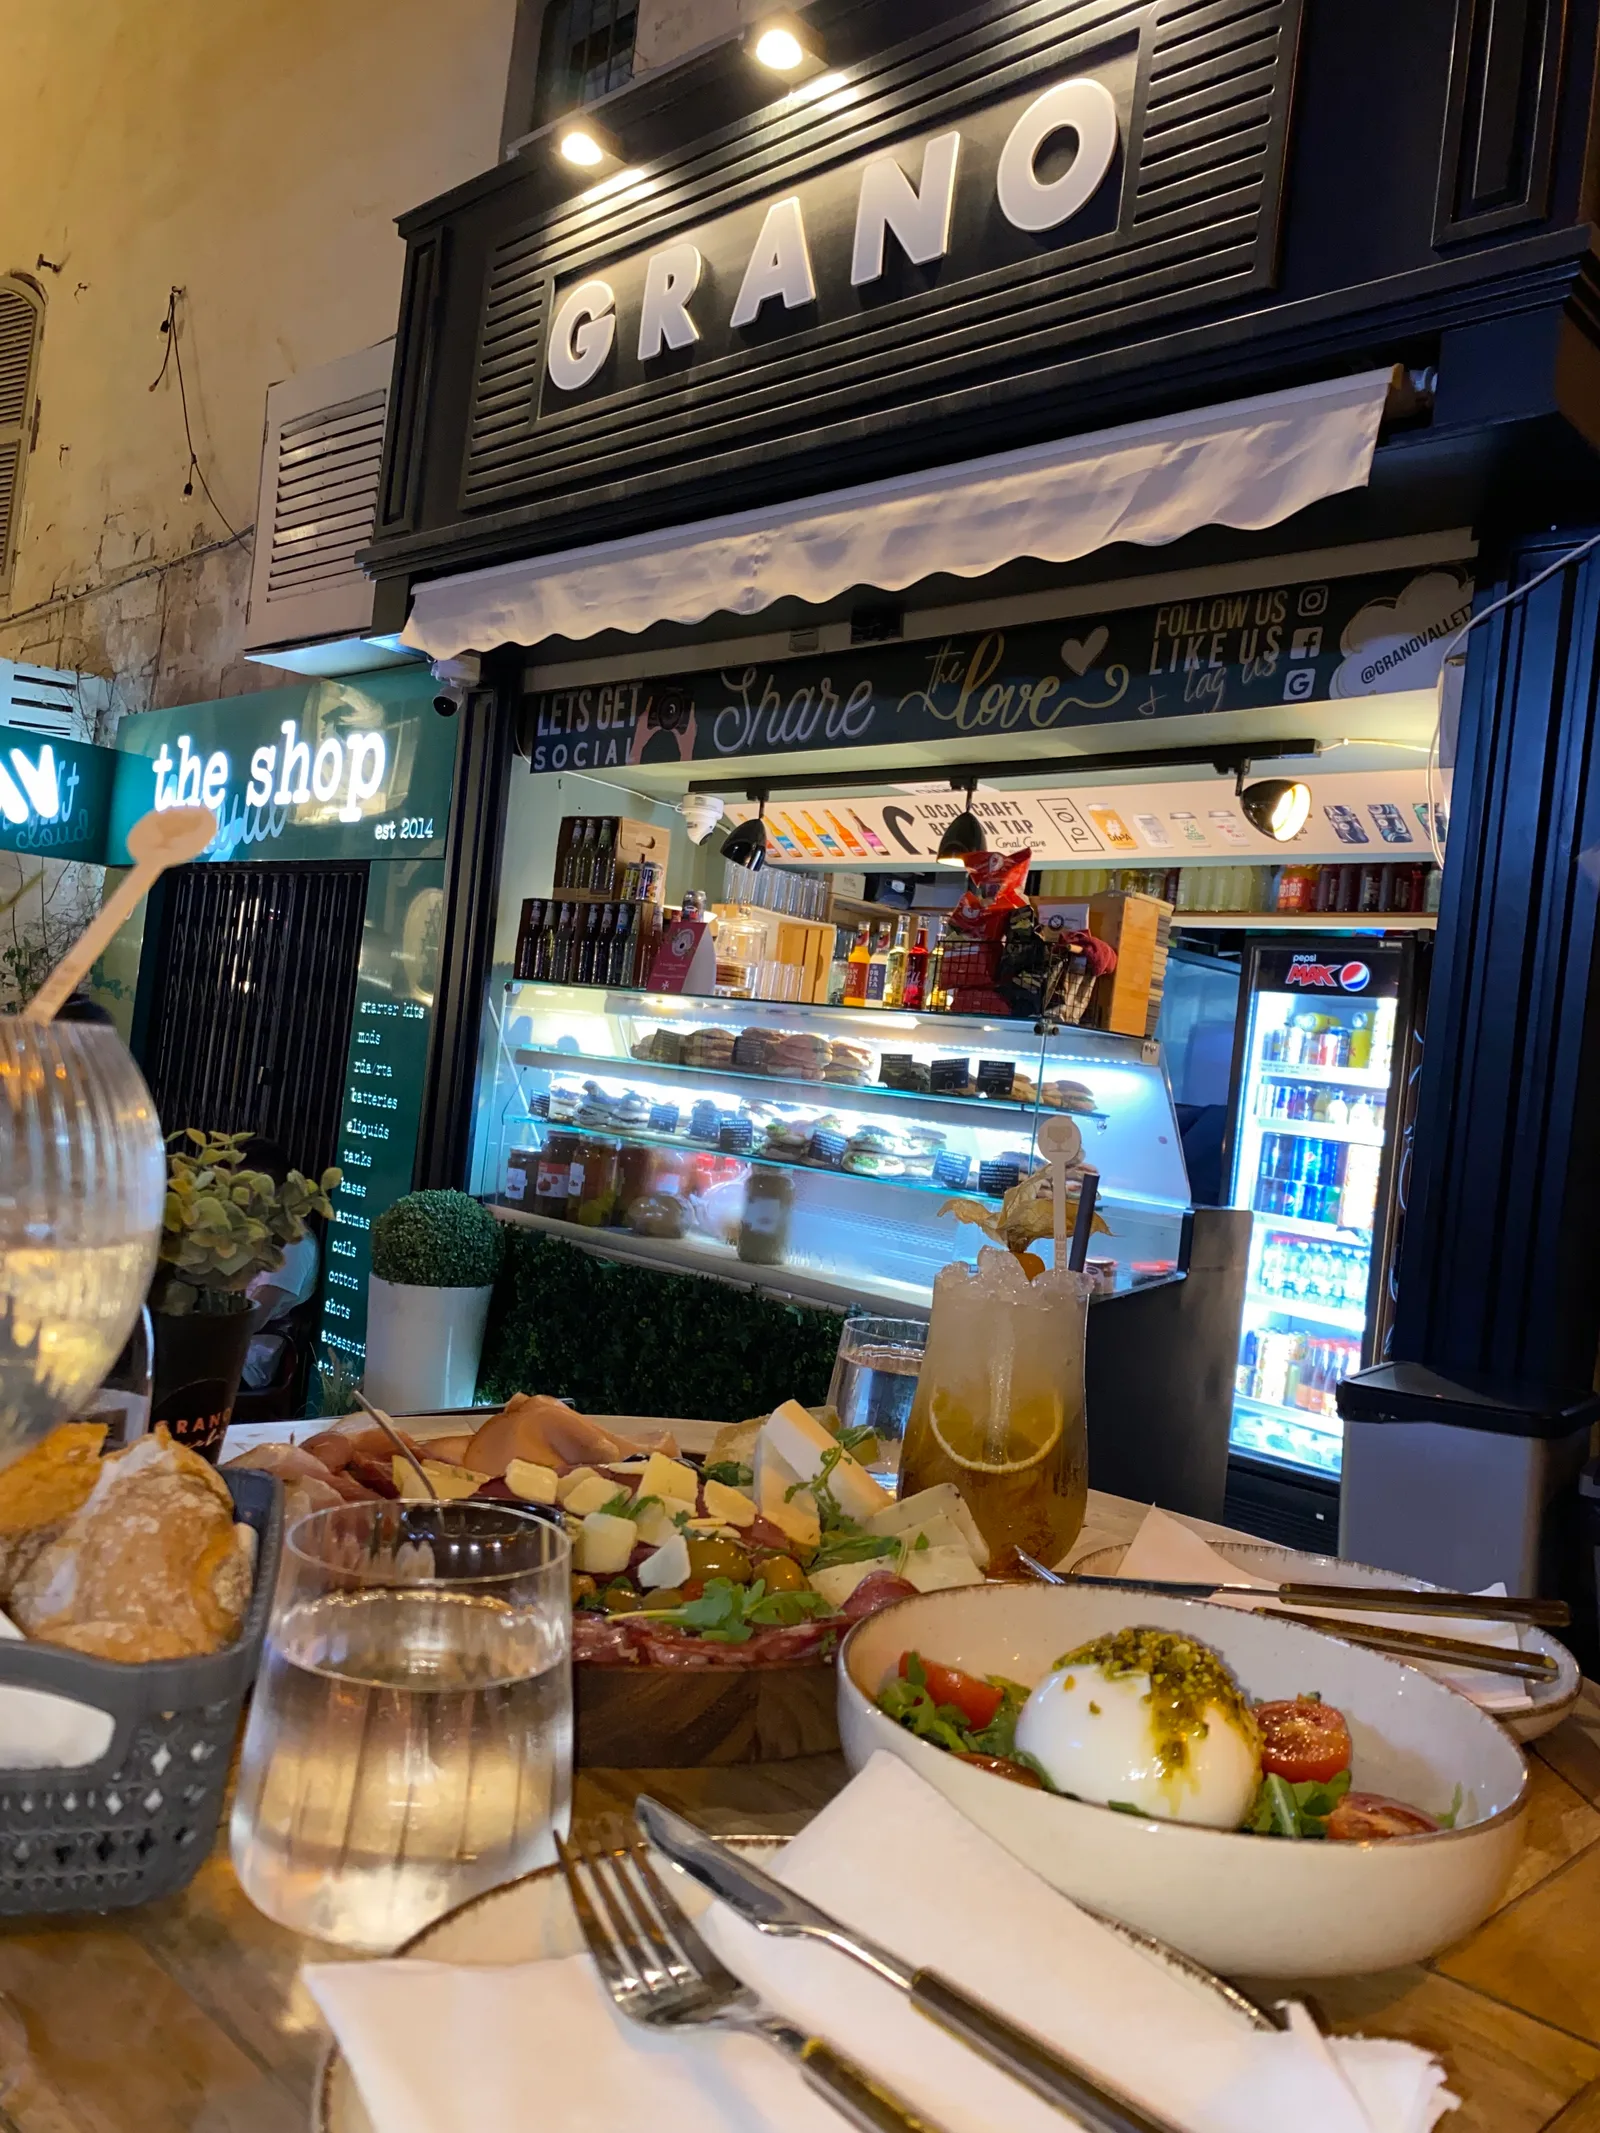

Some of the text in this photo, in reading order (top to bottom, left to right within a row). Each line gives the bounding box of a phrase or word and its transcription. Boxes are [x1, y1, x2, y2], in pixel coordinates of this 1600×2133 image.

[547, 77, 1121, 391] GRANO
[1154, 590, 1288, 638] FOLLOW US
[1149, 626, 1283, 676] LIKE US
[1242, 655, 1277, 684] us
[925, 632, 1129, 730] the love
[537, 682, 643, 737] LETS GET
[713, 666, 876, 753] Share
[534, 737, 636, 770] SOCIAL
[152, 735, 229, 812] the
[246, 720, 386, 823] shop
[969, 801, 1023, 818] CRAFT
[375, 817, 434, 840] est 2014
[1001, 820, 1034, 835] TAP
[995, 836, 1047, 848] Coral Cave
[1292, 954, 1317, 963] pepsi
[1285, 963, 1342, 987] MAX
[361, 1001, 425, 1019] starter kits
[357, 1030, 381, 1045] mods
[354, 1059, 393, 1077] rda/rta
[350, 1087, 398, 1110] batteries
[346, 1118, 390, 1140] eliquids
[344, 1149, 372, 1167] tanks
[340, 1177, 367, 1197] bases
[336, 1210, 371, 1230] aromas
[332, 1240, 357, 1258] coils
[328, 1270, 359, 1290] cotton
[325, 1298, 351, 1319] shots
[156, 1407, 231, 1434] RANO
